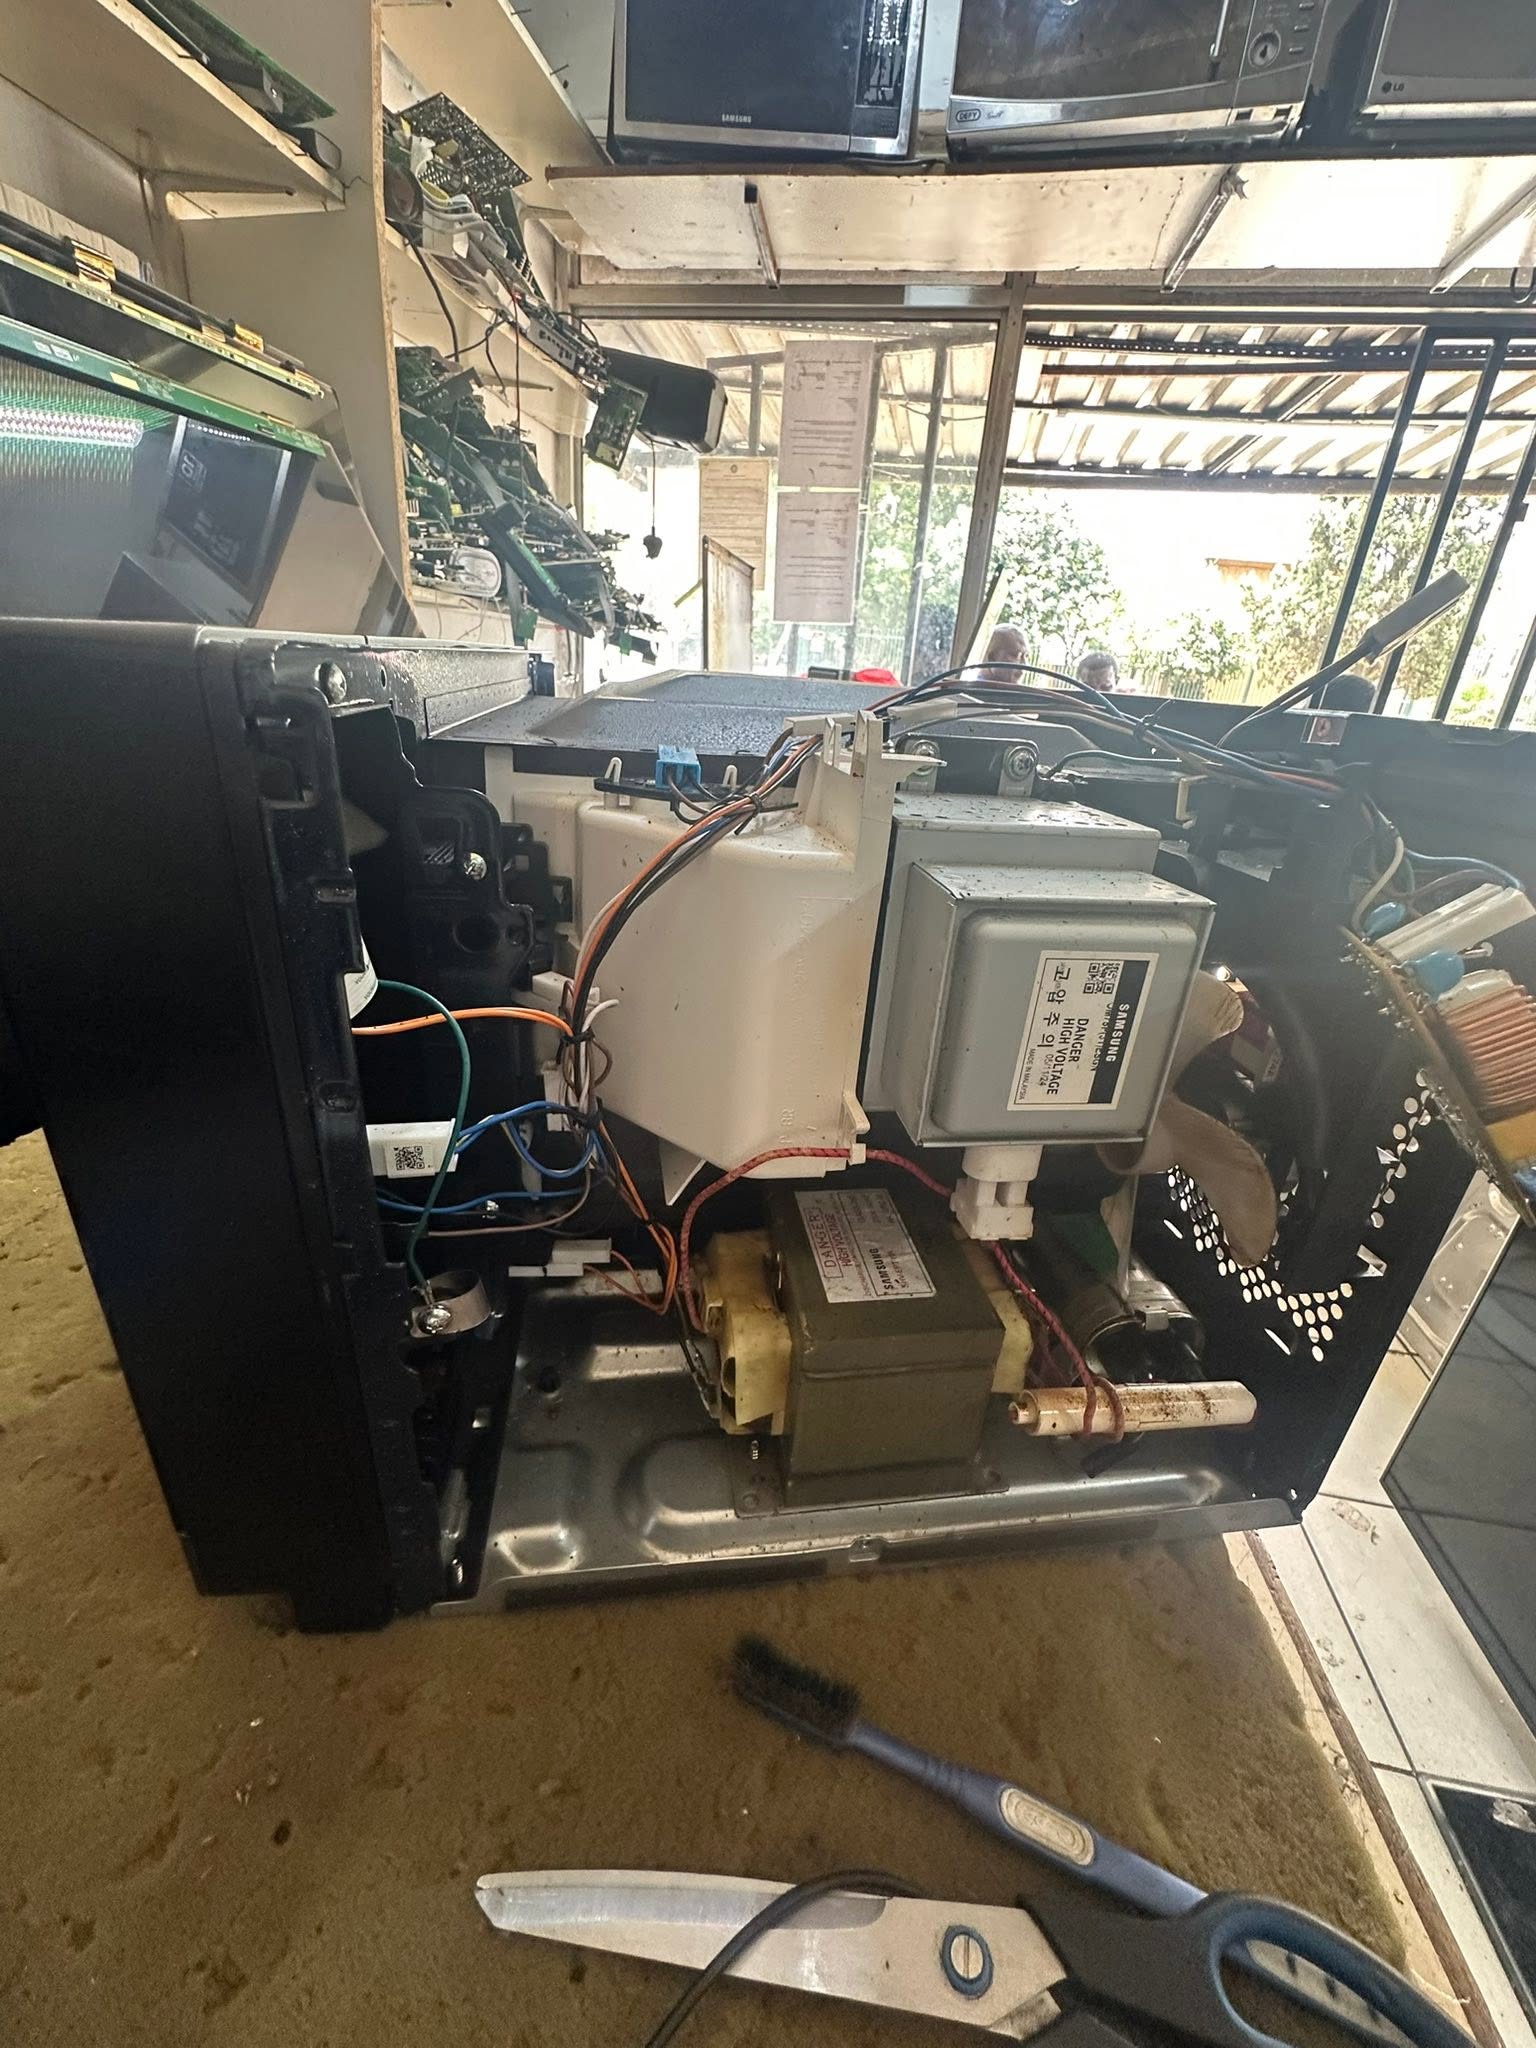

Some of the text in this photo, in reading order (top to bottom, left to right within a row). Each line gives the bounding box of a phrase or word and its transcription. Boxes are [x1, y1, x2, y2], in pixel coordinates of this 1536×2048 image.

[1068, 1018, 1089, 1061] DANGER
[1105, 1003, 1130, 1061] SAMSUNG
[1046, 1018, 1075, 1094] HIGH VOLTAGE
[808, 1214, 836, 1267] DANGER
[823, 1213, 845, 1246] VOLTAGE
[835, 1247, 852, 1266] HIGH
[868, 1247, 894, 1289] SAMSUNG
